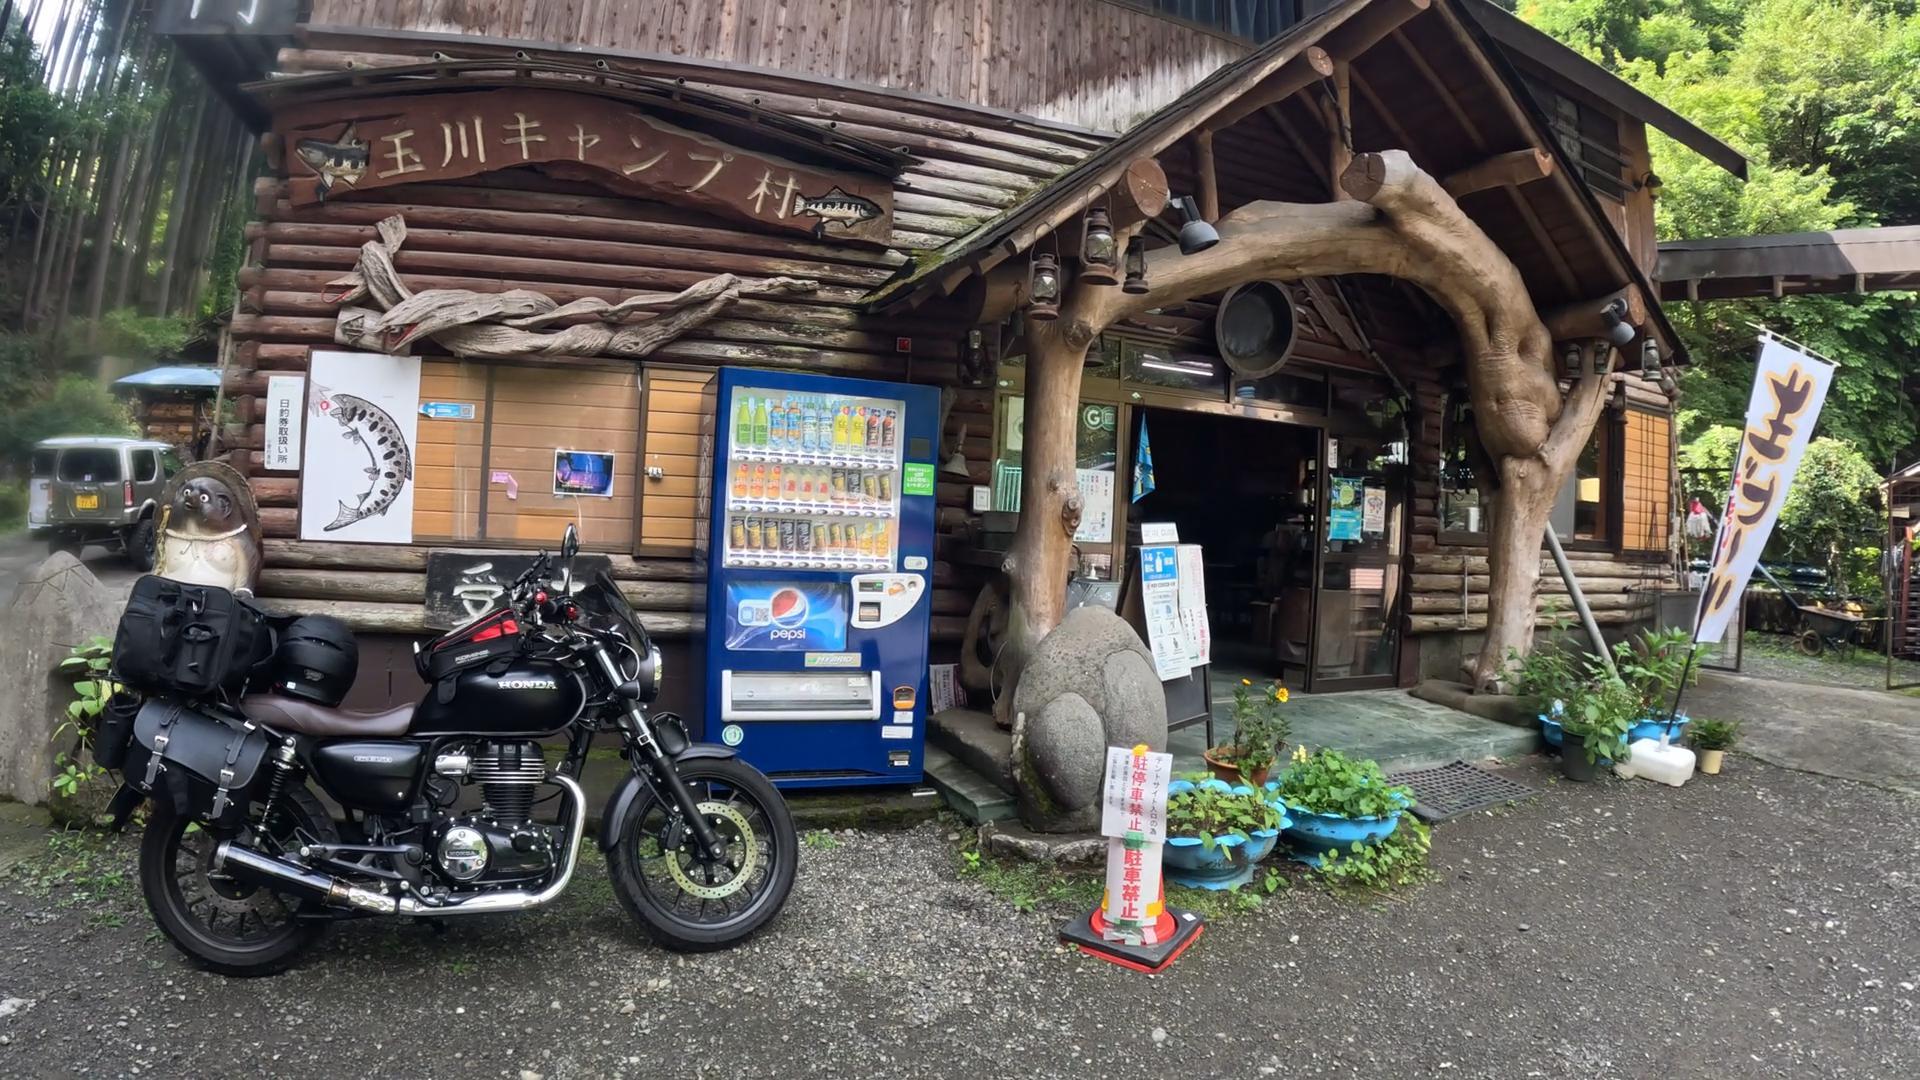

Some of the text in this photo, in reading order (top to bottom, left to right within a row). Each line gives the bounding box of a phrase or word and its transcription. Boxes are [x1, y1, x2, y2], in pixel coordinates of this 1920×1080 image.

[376, 112, 801, 220] 玉川キャンプ村
[770, 628, 806, 641] pepsi
[497, 680, 558, 690] HONDA
[1127, 753, 1148, 832] 駐停車禁止
[1120, 847, 1143, 920] 駐車禁止
